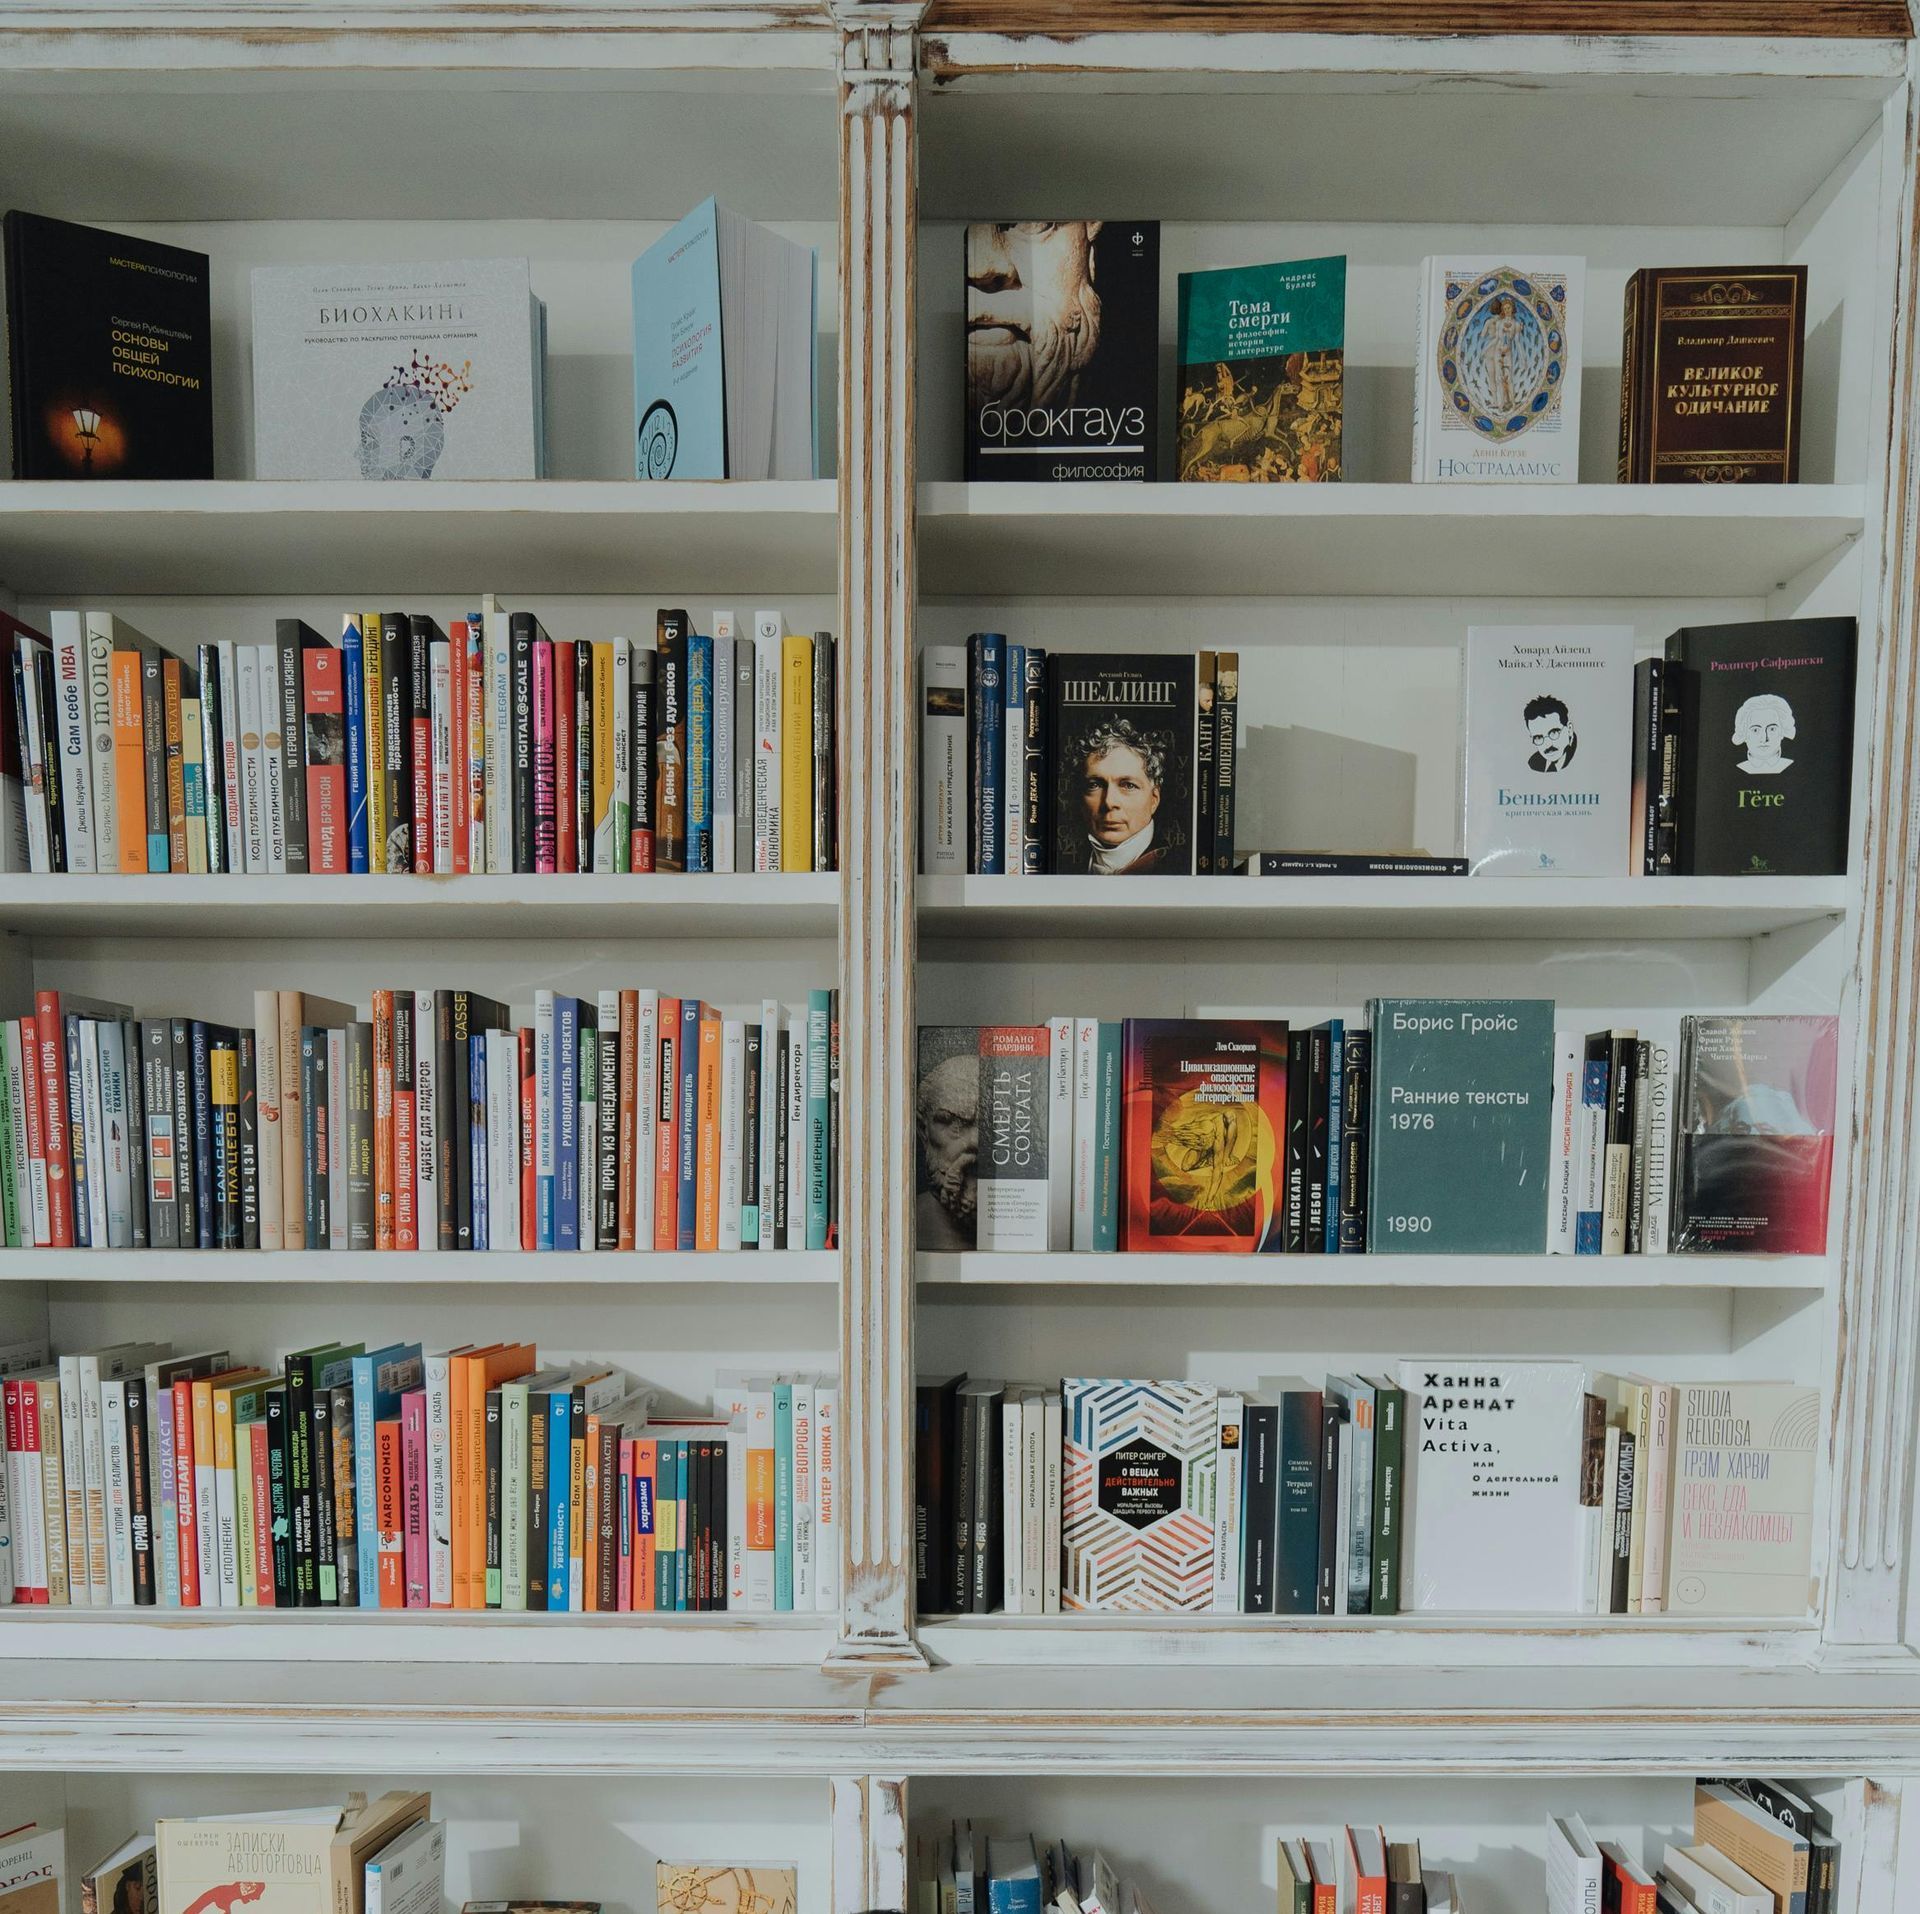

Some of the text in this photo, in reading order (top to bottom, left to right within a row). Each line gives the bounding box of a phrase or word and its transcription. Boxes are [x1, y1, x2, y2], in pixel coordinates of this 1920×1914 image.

[1280, 273, 1316, 282] Андреас
[1286, 281, 1316, 290] Буллер
[1229, 300, 1271, 315] Тема
[1229, 312, 1290, 330] смерти
[111, 316, 192, 340] Сергей Рубинштейн
[112, 330, 168, 351] ОСНОВЫ
[1229, 339, 1263, 347] истории
[1678, 335, 1775, 346] Владимир Дашкевич
[112, 347, 159, 365] ОБЩЕЙ
[1237, 345, 1284, 355] литературе
[113, 362, 199, 389] ПСИХОЛОГИИ
[1684, 367, 1763, 380] ВЕЛИКОЕ
[1667, 383, 1779, 398] КУЛЬТУРНОЕ
[980, 400, 1144, 446] брокгауз
[1675, 401, 1770, 416] ОДИЧАНИЕ
[1052, 463, 1144, 480] философия
[1499, 659, 1532, 669] Майкл
[1546, 659, 1605, 669] Дженнингс
[1514, 645, 1591, 656] Ховард Айленд
[1710, 657, 1823, 671] Рюдигер Сафрански
[90, 630, 112, 725] money
[1064, 681, 1176, 702] ШЕЛЛИНГ
[498, 674, 508, 731] TELEGRAM
[518, 660, 528, 768] DIGITAL@SCALE
[61, 645, 88, 832] Джош Кауфман Сам себе MBA
[664, 662, 676, 806] Деньги без дураков
[1199, 721, 1213, 761] КАНТ
[1219, 708, 1233, 787] ШОПЕНГАУЭР
[225, 741, 239, 827] СОЗДАНИЕ БРЕНДОВ
[414, 727, 427, 853] СТАНЬ ЛИДЕРОМ РЫНКА!
[534, 740, 555, 815] ПИРАТОМ
[247, 758, 260, 860] КОД ПУБЛИЧНОСТИ
[270, 757, 283, 860] КОД ПУБЛИЧНОСТИ
[757, 759, 767, 837] ПОВЕДЕНЧЕСКАЯ
[1499, 789, 1600, 806] Беньямин
[1505, 810, 1562, 818] критическая
[1738, 790, 1784, 808] Гёте
[320, 777, 334, 868] РИЧАРД БРЭНСОН
[768, 807, 779, 871] ЭКОНОМИКА
[982, 787, 994, 861] ФИЛОСОФИЯ
[1393, 1013, 1518, 1035] Борис Гройс
[624, 1003, 635, 1100] ПСИХОЛОГИЯ УБЕЖДЕНИЯ
[1215, 1042, 1256, 1052] Лев Скворцов
[562, 1011, 572, 1147] РУКОВОДИТЕЛЬ ПРОЕКТОВ
[662, 1042, 672, 1119] МЕНЕДЖМЕНТ
[791, 1044, 802, 1121] Ген директора
[1181, 1061, 1256, 1073] Цивилизационные
[1211, 1073, 1255, 1083] опасности:
[43, 1042, 64, 1150] Закупки на 100%
[111, 1072, 122, 1112] техники
[1194, 1093, 1254, 1104] интерпретация
[1200, 1081, 1254, 1093] философская
[1391, 1087, 1529, 1105] Ранние тексты
[11, 1066, 25, 1170] ИСКРЕННИЙ СЕРВИС
[69, 1071, 85, 1159] ТУРБО КОМАНДА
[419, 1061, 433, 1181] АДИЗЕС ДЛЯ ЛИДЕРОВ
[603, 1041, 616, 1190] ПРОЧЬ ИЗ МЕНЕДЖМЕНТА!
[810, 1011, 826, 1204] ГЕРД ГИГЕРЕНЦЕР ПОНИМАТЬ РИСКИ
[992, 1071, 1011, 1165] СМЕРТЬ
[1015, 1072, 1031, 1166] СОКРАТА
[1390, 1114, 1435, 1130] 1976
[1648, 1048, 1668, 1207] МИШЕЛЬ ФУКО
[226, 1112, 238, 1202] ПЛАЦЕБО
[349, 1124, 359, 1174] Привычки
[1290, 1168, 1301, 1226] ПАСКАЛЬ
[1311, 1183, 1321, 1224] ЛЕБОН
[1387, 1216, 1432, 1232] 1990
[1424, 1373, 1500, 1388] Ханна
[1423, 1396, 1515, 1413] Арендт
[1687, 1389, 1732, 1417] STUDIA
[1424, 1418, 1468, 1430] Vita
[1686, 1418, 1751, 1447] RELIGIOSA
[161, 1419, 173, 1490] ПОДКАСТ
[796, 1418, 809, 1473] ВОПРОСЫ
[1115, 1452, 1166, 1460] ПИТЕР СИНГЕР
[1423, 1439, 1500, 1454] Activa,
[359, 1402, 373, 1532] НА ОДНОЙ ВОЛНЕ
[382, 1434, 392, 1527] NARCONOMICS
[1130, 1468, 1159, 1478] ВЕЩАХ
[1617, 1442, 1634, 1509] МАКСИМЫ
[1684, 1450, 1770, 1480] ГРЭМ ХАРВИ
[177, 1455, 192, 1526] СДЕЛАЙ!
[1105, 1477, 1175, 1487] ДЕЙСТВИТЕЛЬНО
[1122, 1488, 1158, 1497] ВАЖНЫХ
[1723, 1484, 1747, 1512] ЕДА
[45, 1456, 64, 1573] РЕЖИМ ГЕНИЯ
[639, 1481, 650, 1529] харизма
[132, 1515, 149, 1550] ДРАЙВ
[1683, 1512, 1793, 1544] И НЕЗНАКОМЦЫ
[163, 1520, 177, 1596] ВЗРЫВНОЙ
[222, 1517, 234, 1584] ИСПОЛНЕНИЕ
[227, 1833, 285, 1852] ЗАПИСКИ
[228, 1853, 321, 1876] АВТОТОРГОВЦА
